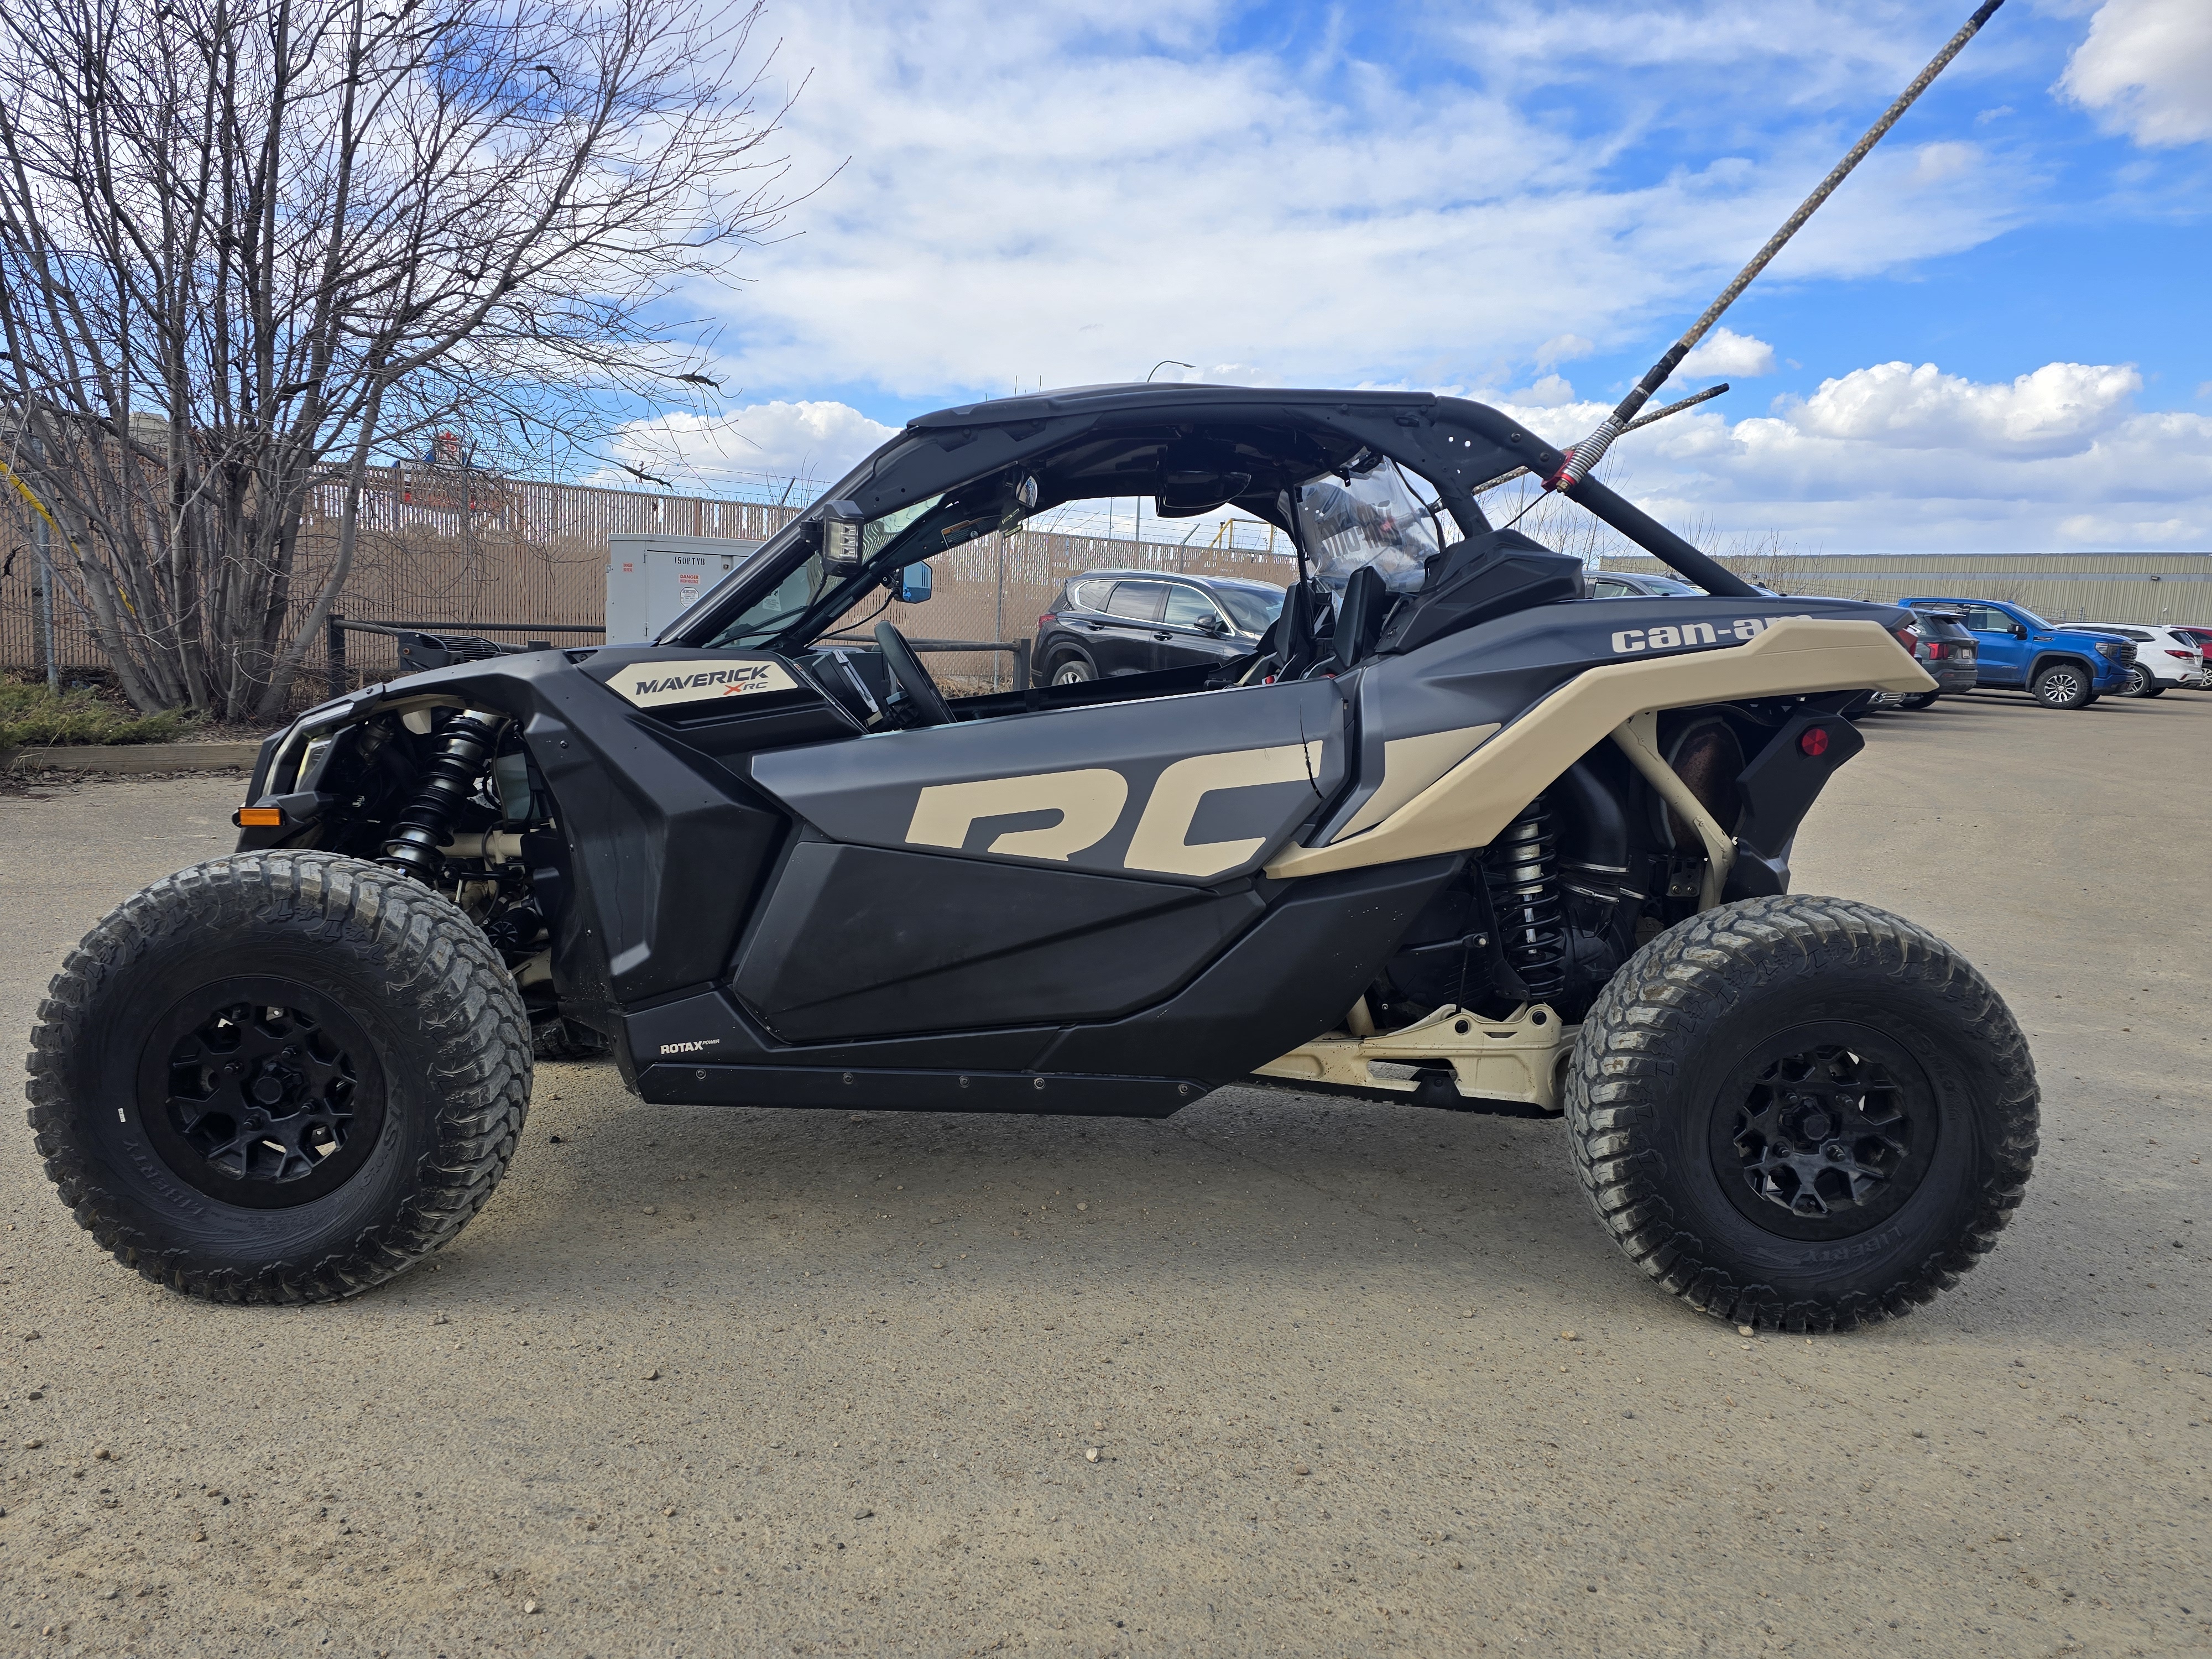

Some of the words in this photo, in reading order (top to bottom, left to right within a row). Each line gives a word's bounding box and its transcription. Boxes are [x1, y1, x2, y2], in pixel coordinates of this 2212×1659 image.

[1611, 614, 1813, 653] can-a
[635, 665, 771, 695] MAVERICK
[905, 740, 1323, 877] RC
[660, 1041, 703, 1055] ROTAX
[122, 1139, 205, 1215] LIBERTY
[1801, 1225, 1902, 1263] LIBERTY
